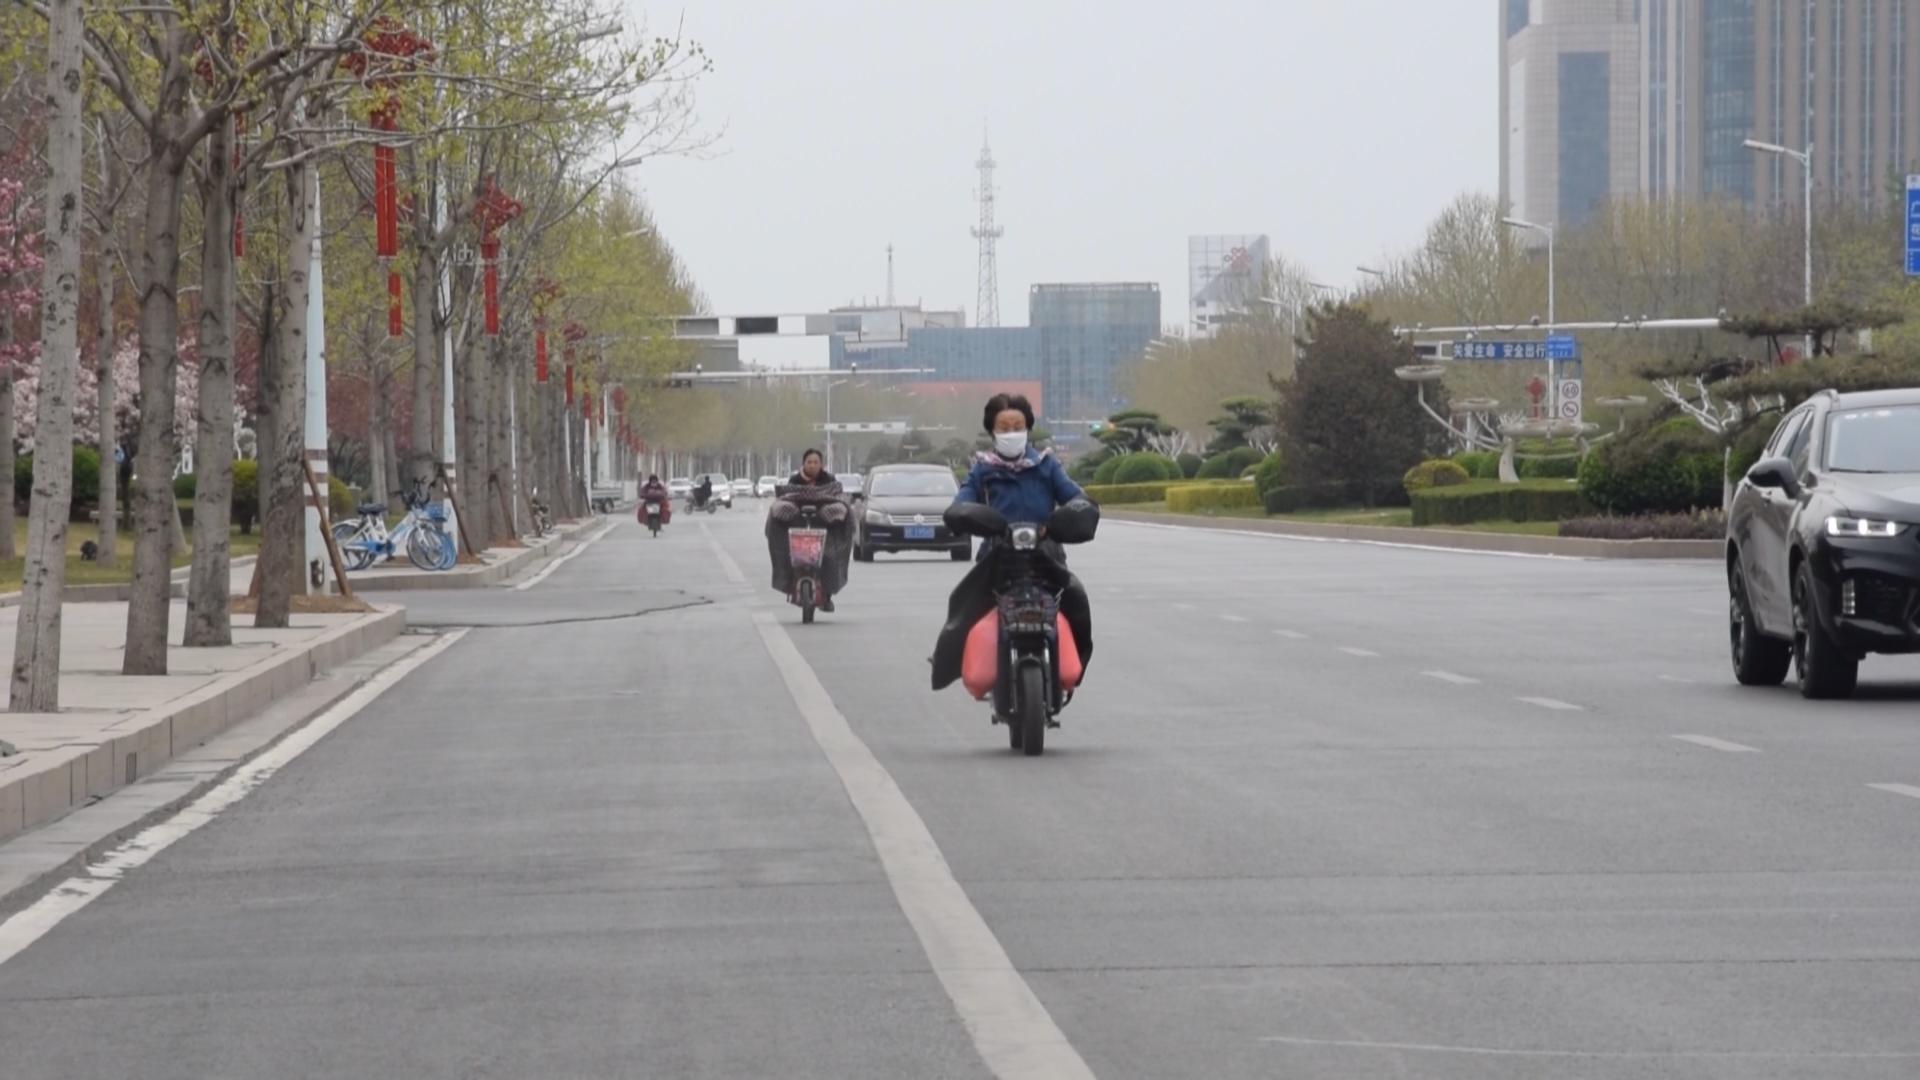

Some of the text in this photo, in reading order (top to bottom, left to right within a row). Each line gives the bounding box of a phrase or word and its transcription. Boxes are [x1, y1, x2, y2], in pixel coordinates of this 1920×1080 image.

[1453, 343, 1496, 358] 关爱生命
[1503, 343, 1546, 358] 安全出行
